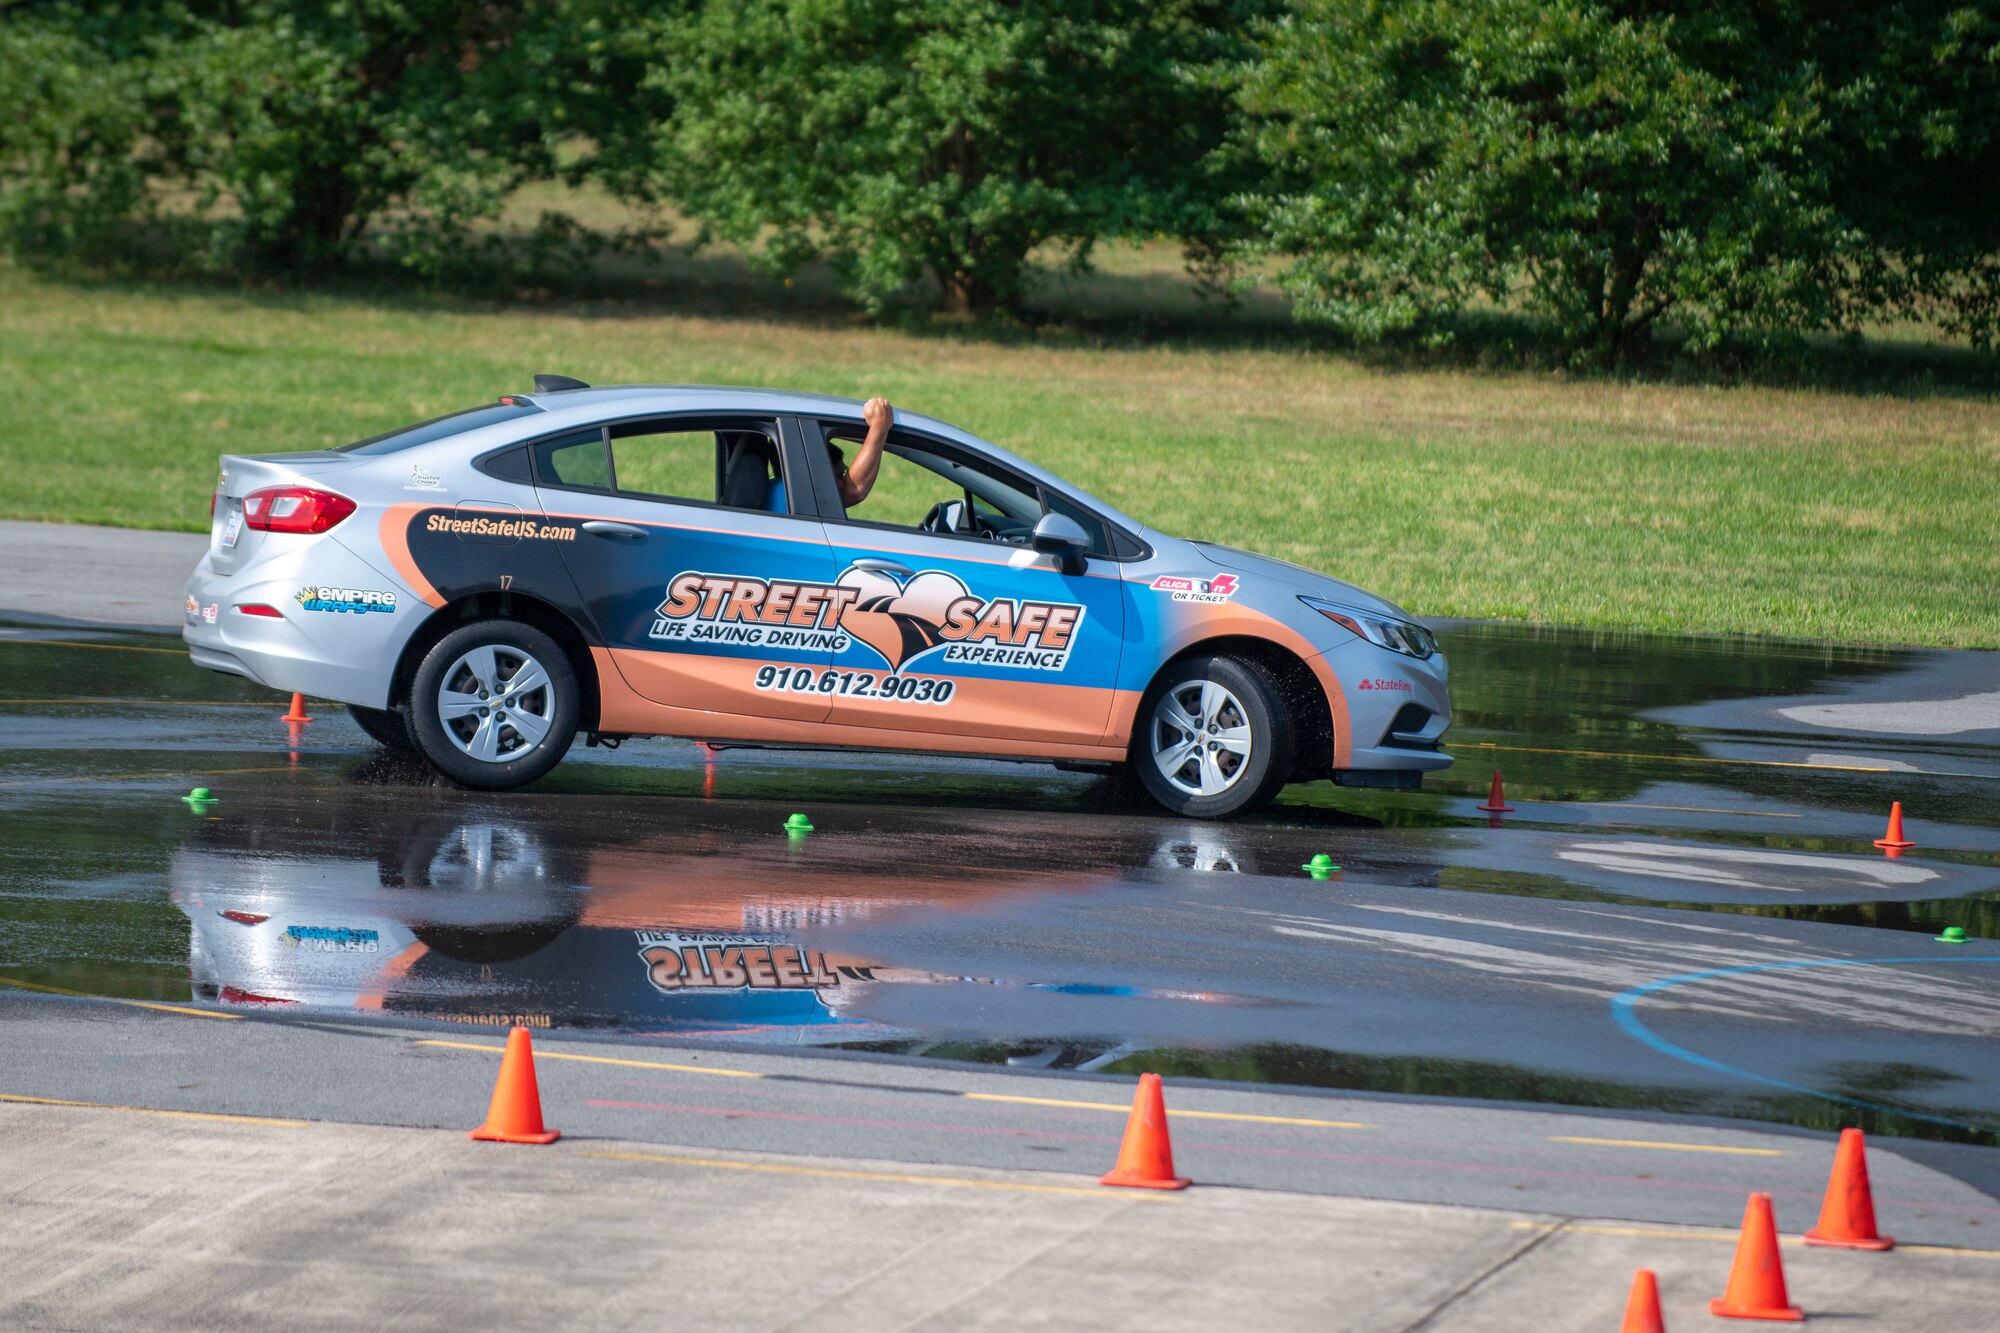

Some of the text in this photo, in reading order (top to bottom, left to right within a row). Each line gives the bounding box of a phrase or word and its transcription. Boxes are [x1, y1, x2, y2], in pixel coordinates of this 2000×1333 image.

[426, 514, 576, 541] StreetSafeUS.com
[500, 575, 513, 590] 17
[1159, 580, 1189, 589] CLICK
[657, 573, 1082, 651] STREET SAFE
[652, 620, 848, 650] LIFE SAVING DRIVING
[946, 645, 1064, 668] EXPERIENCE
[756, 665, 953, 703] 910.612.9030
